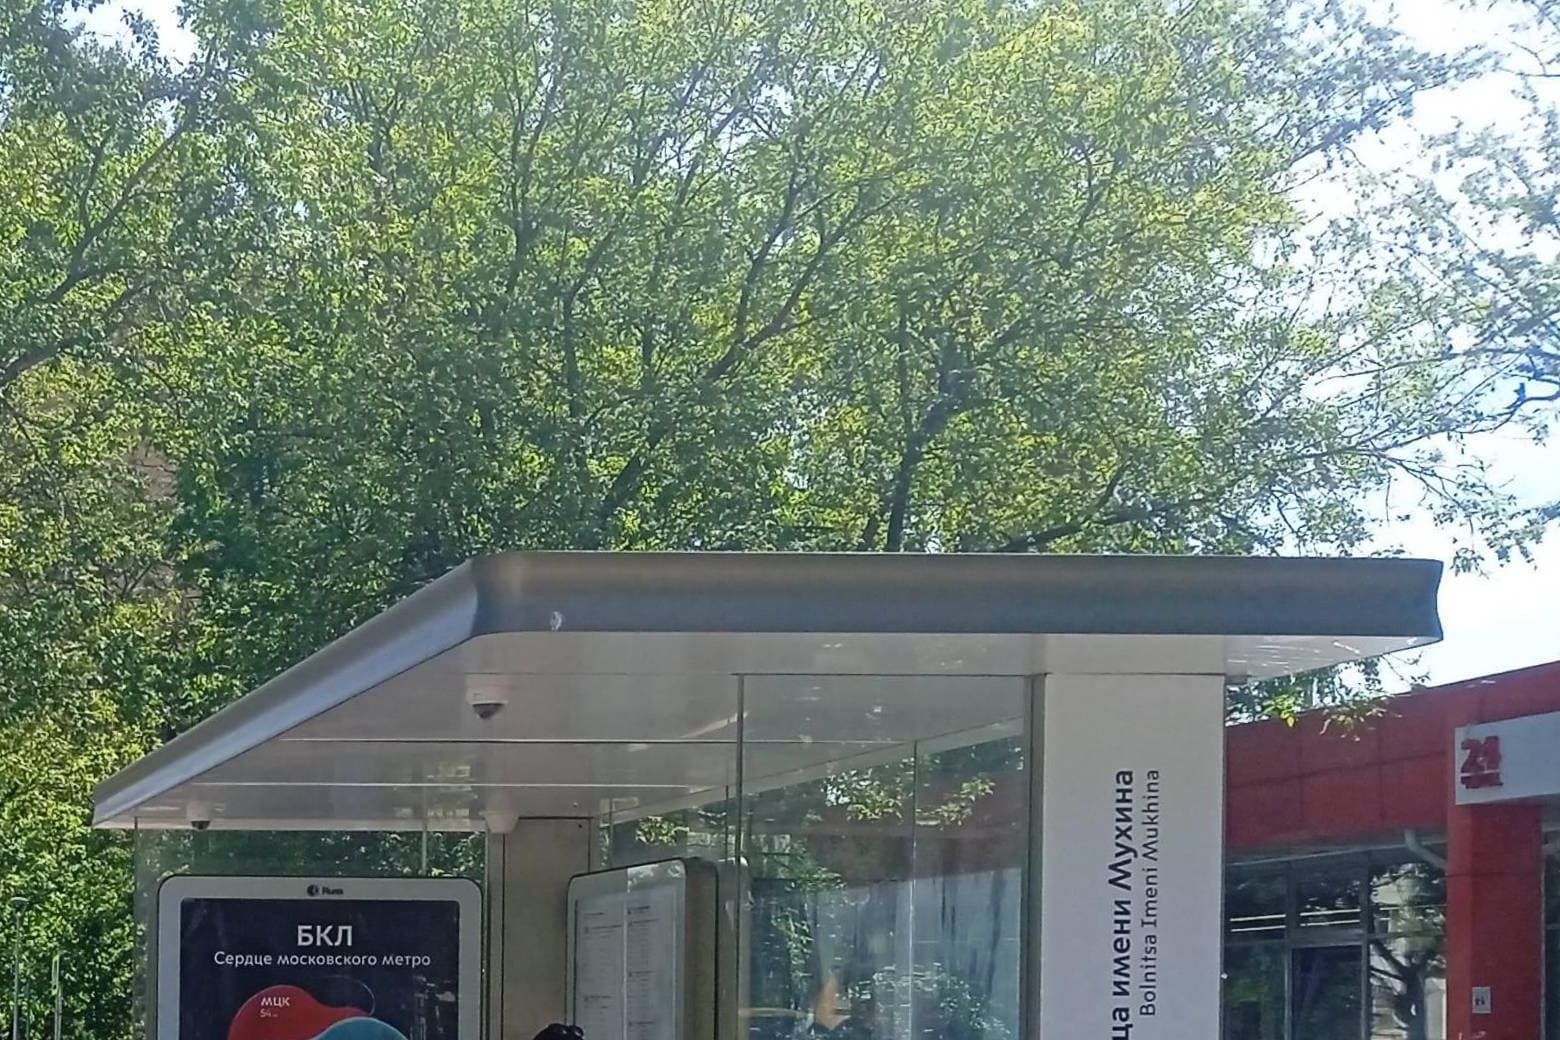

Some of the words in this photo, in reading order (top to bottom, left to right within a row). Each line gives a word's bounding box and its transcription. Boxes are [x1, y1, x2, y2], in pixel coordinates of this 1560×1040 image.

[1108, 769, 1138, 892] Мухина
[1141, 769, 1160, 862] Mukhina
[1140, 867, 1159, 929] Imeni
[214, 951, 273, 968] Сердце
[276, 954, 378, 967] московского
[382, 954, 432, 968] метро
[296, 925, 353, 947] БКЛ
[1111, 899, 1132, 997] имени
[260, 996, 290, 1008] МЦК
[1139, 933, 1158, 1016] Bolnitsa
